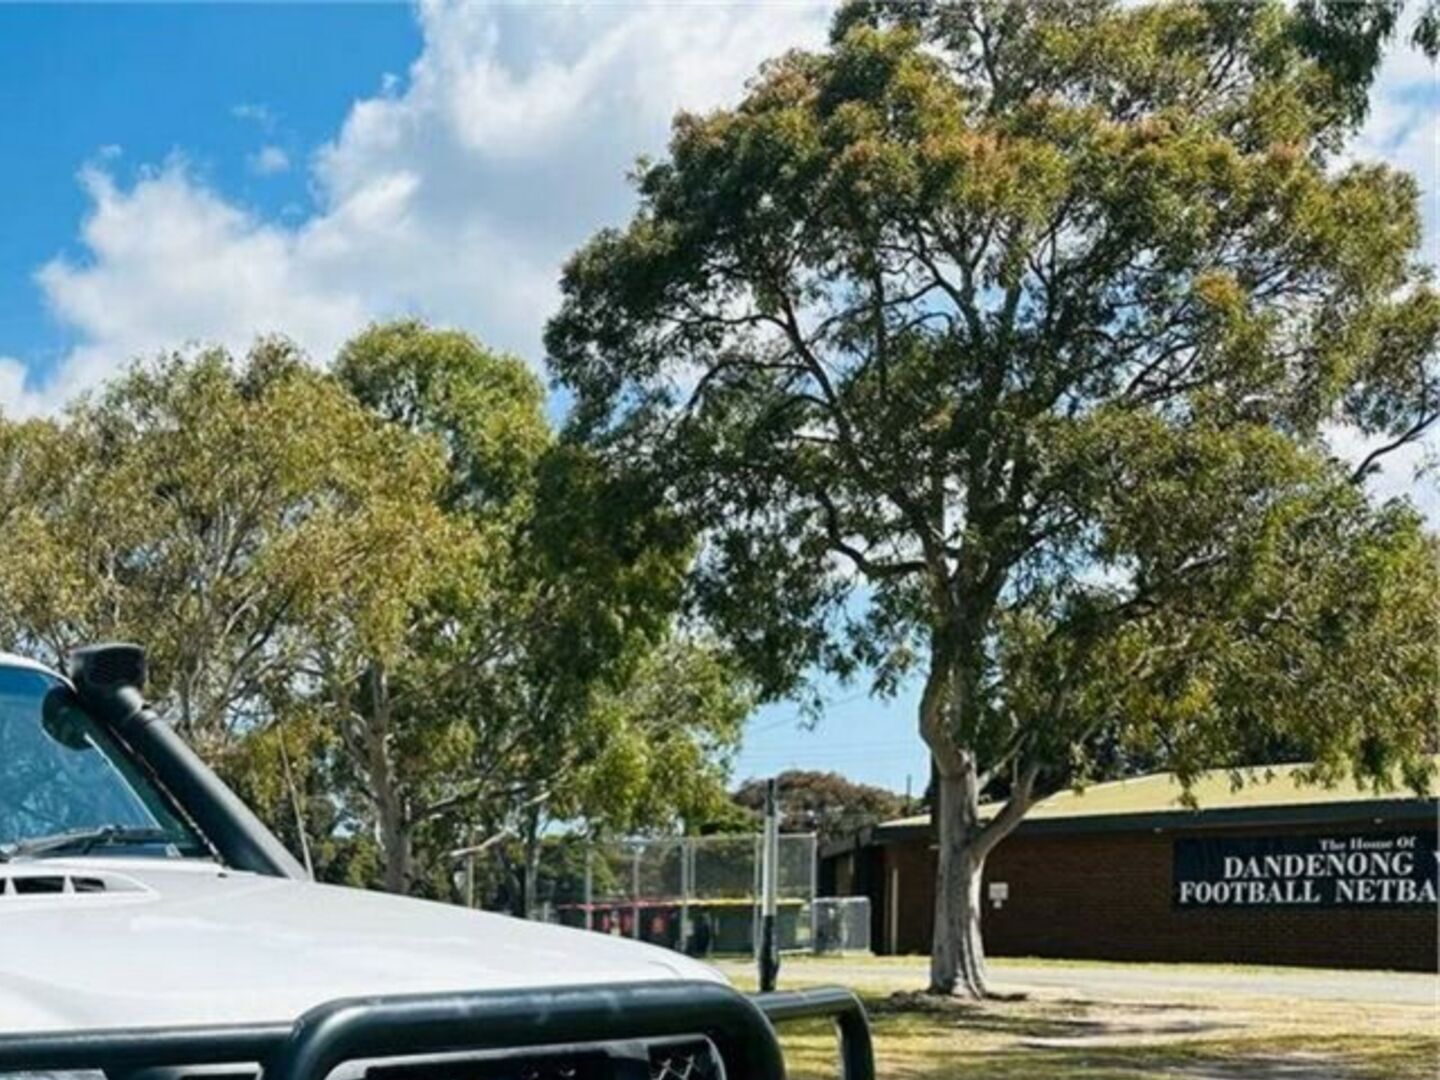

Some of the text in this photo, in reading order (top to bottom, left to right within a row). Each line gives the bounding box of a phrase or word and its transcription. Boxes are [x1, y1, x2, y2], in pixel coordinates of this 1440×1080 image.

[1319, 838, 1346, 851] The
[1349, 836, 1394, 850] Home
[1223, 851, 1414, 879] DANDENONG
[1179, 880, 1322, 903] FOOTBALL
